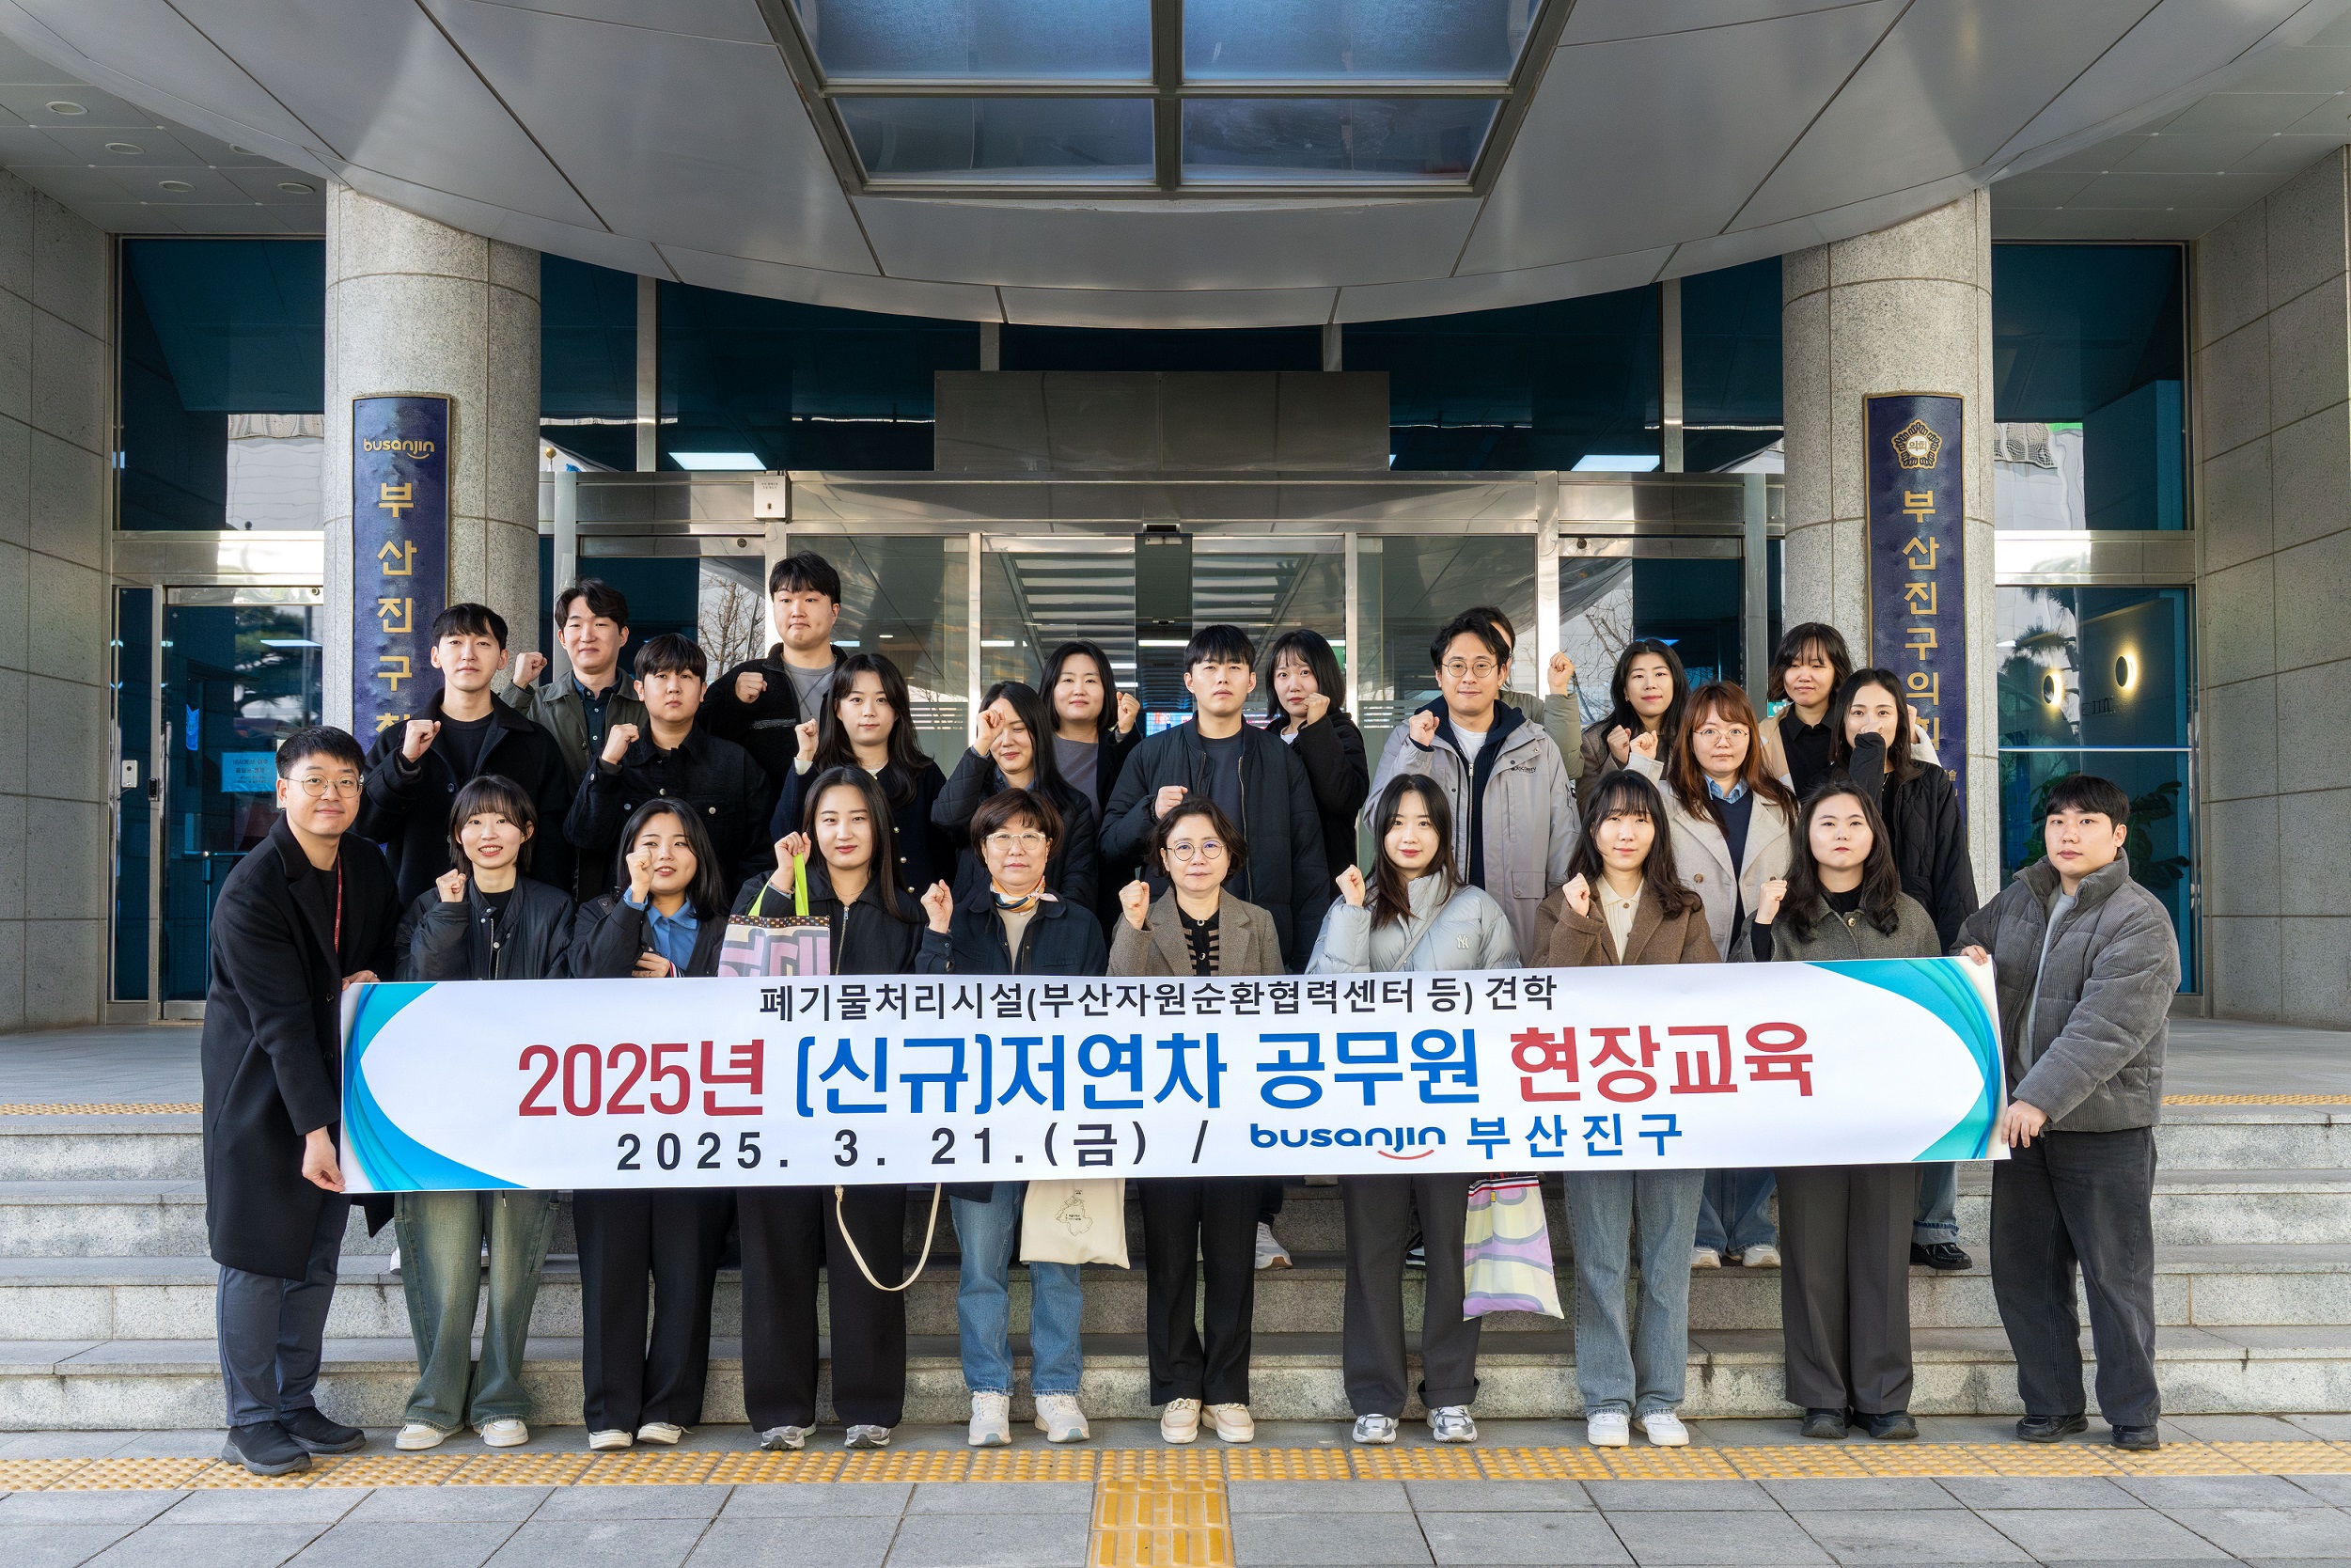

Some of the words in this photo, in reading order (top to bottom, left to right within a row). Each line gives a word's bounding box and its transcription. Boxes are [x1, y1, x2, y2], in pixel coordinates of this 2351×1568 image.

[363, 437, 435, 460] busanjin
[760, 979, 1413, 1022] 폐기물처리시설(부산자원순환협력센터
[1427, 979, 1473, 1015] 등)
[1486, 975, 1558, 1011] 견학
[518, 1039, 764, 1117] 2025년
[1256, 1028, 1480, 1109] 공무원
[1510, 1022, 1813, 1105] 현장교육
[617, 1131, 789, 1171] 2025.
[834, 1129, 886, 1168] 3.
[1249, 1122, 1447, 1160] busanjin
[1467, 1113, 1683, 1160] 부산진구
